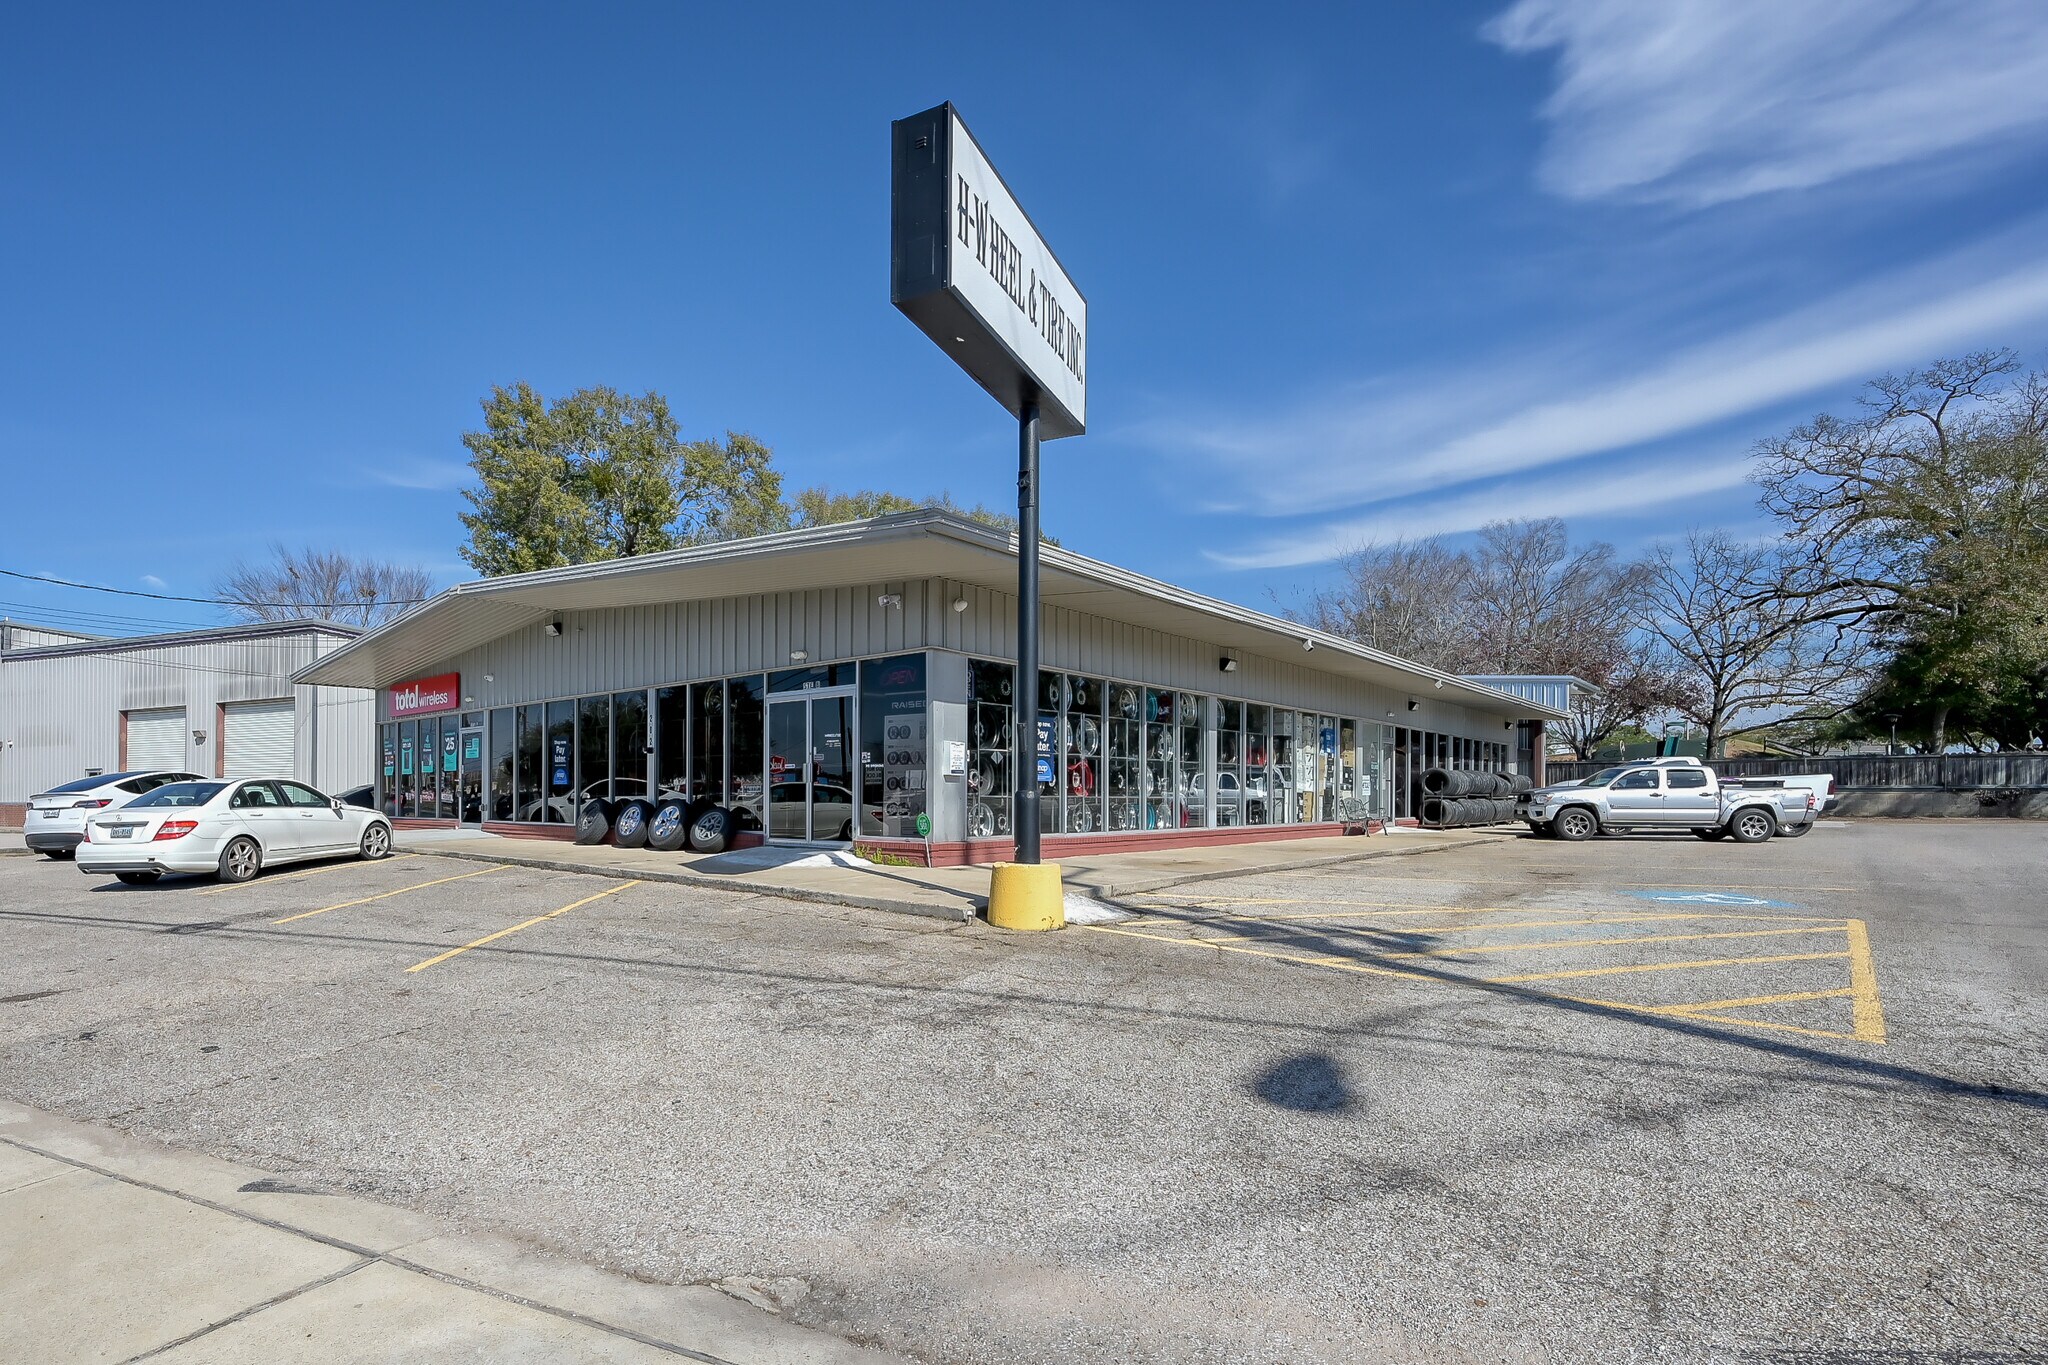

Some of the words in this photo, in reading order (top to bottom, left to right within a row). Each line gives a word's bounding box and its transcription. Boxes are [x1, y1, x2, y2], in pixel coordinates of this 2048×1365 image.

[957, 172, 1025, 314] H-WHEEL
[1029, 268, 1038, 328] &
[1039, 279, 1065, 362] TIRE
[1067, 316, 1083, 385] INC.
[880, 669, 917, 686] OPEN
[395, 684, 418, 710] total
[419, 690, 448, 708] wireless
[556, 745, 565, 755] Pay
[1037, 741, 1050, 751] ter.
